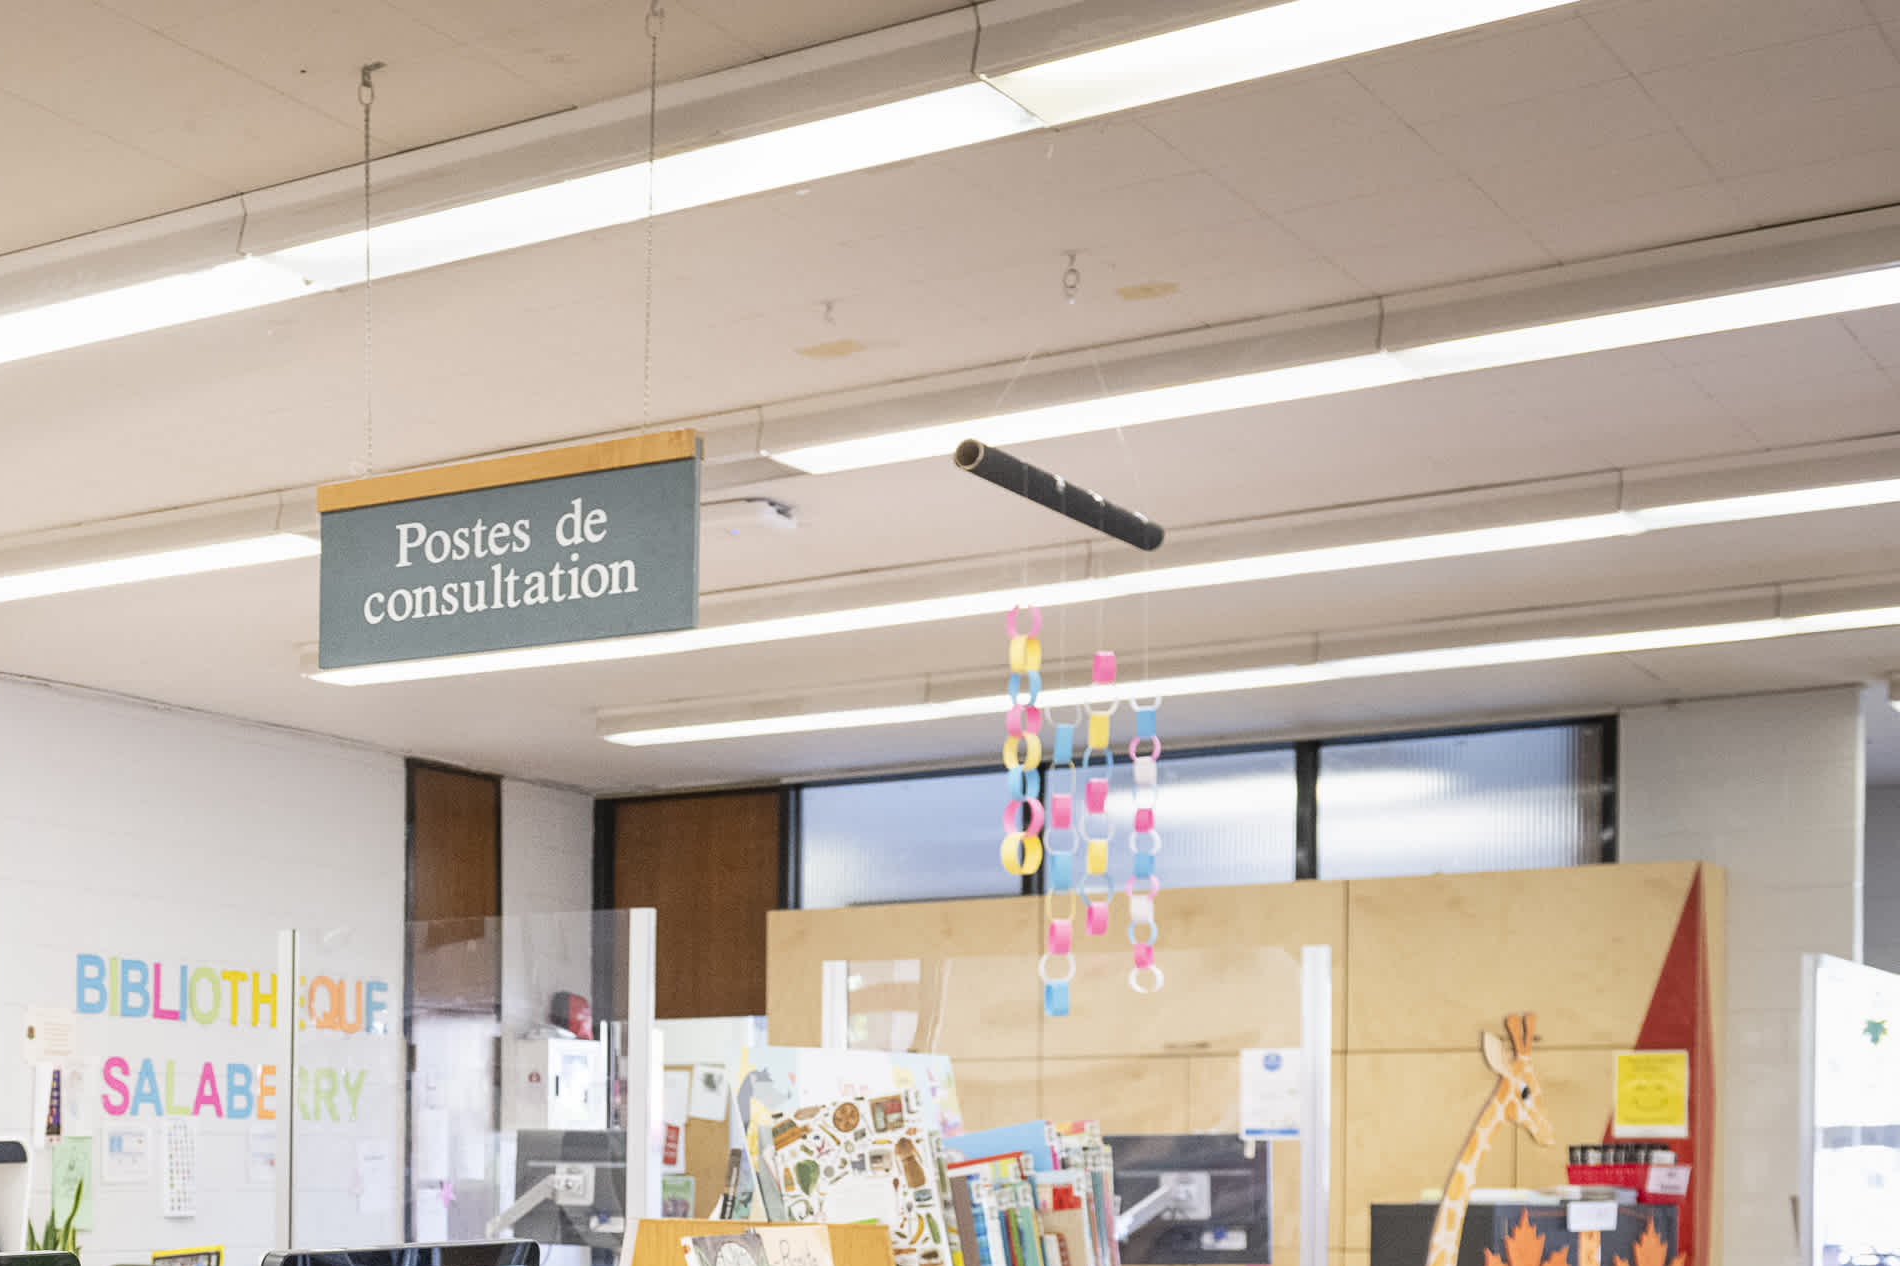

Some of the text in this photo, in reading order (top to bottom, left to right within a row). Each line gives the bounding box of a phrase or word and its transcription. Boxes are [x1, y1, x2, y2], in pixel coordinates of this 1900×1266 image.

[395, 498, 608, 568] Postes de
[363, 553, 640, 625] consultation
[76, 953, 389, 1036] BIBLIOTHQUE
